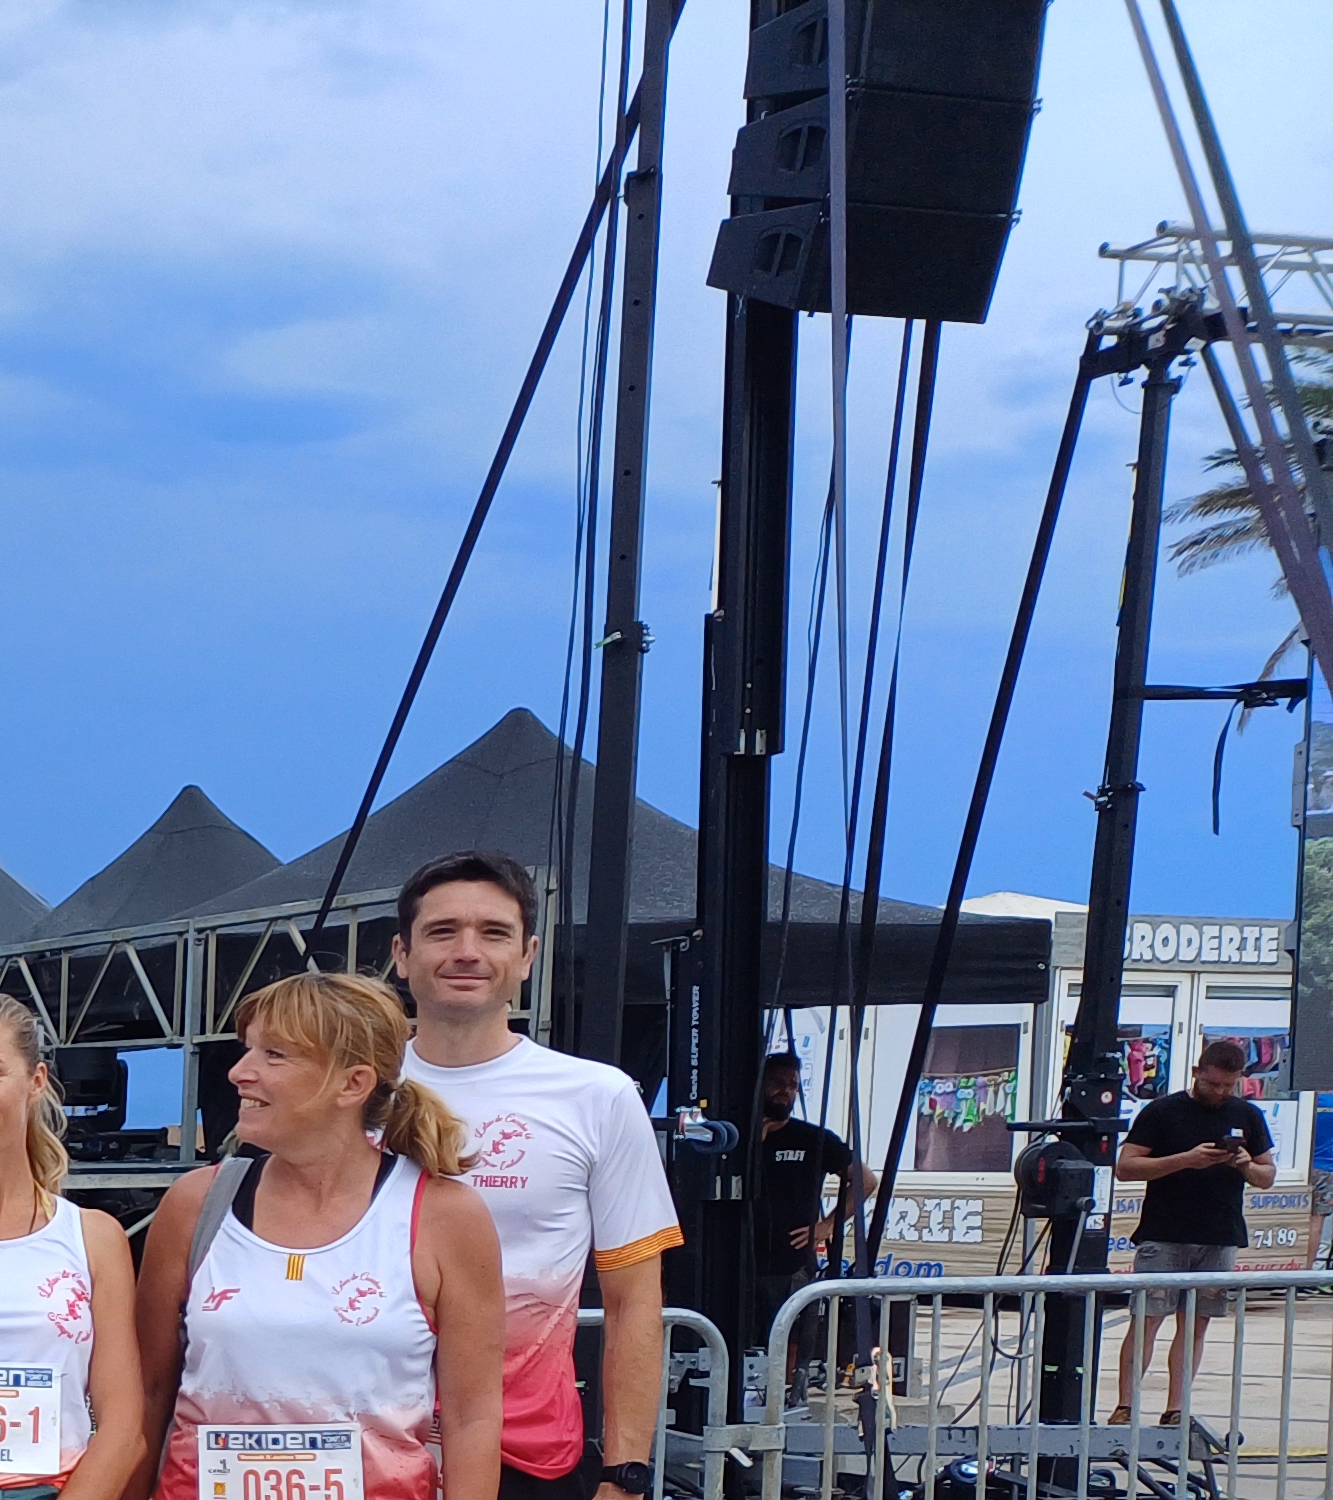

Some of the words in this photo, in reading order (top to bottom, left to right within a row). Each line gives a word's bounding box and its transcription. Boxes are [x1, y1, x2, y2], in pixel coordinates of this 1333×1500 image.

[1122, 921, 1279, 965] RODERIE
[690, 1027, 700, 1067] SUPER
[470, 1174, 529, 1189] THIERRY
[1249, 1193, 1310, 1210] SUPPORTS
[1254, 1229, 1272, 1250] 74
[1276, 1227, 1298, 1249] 89
